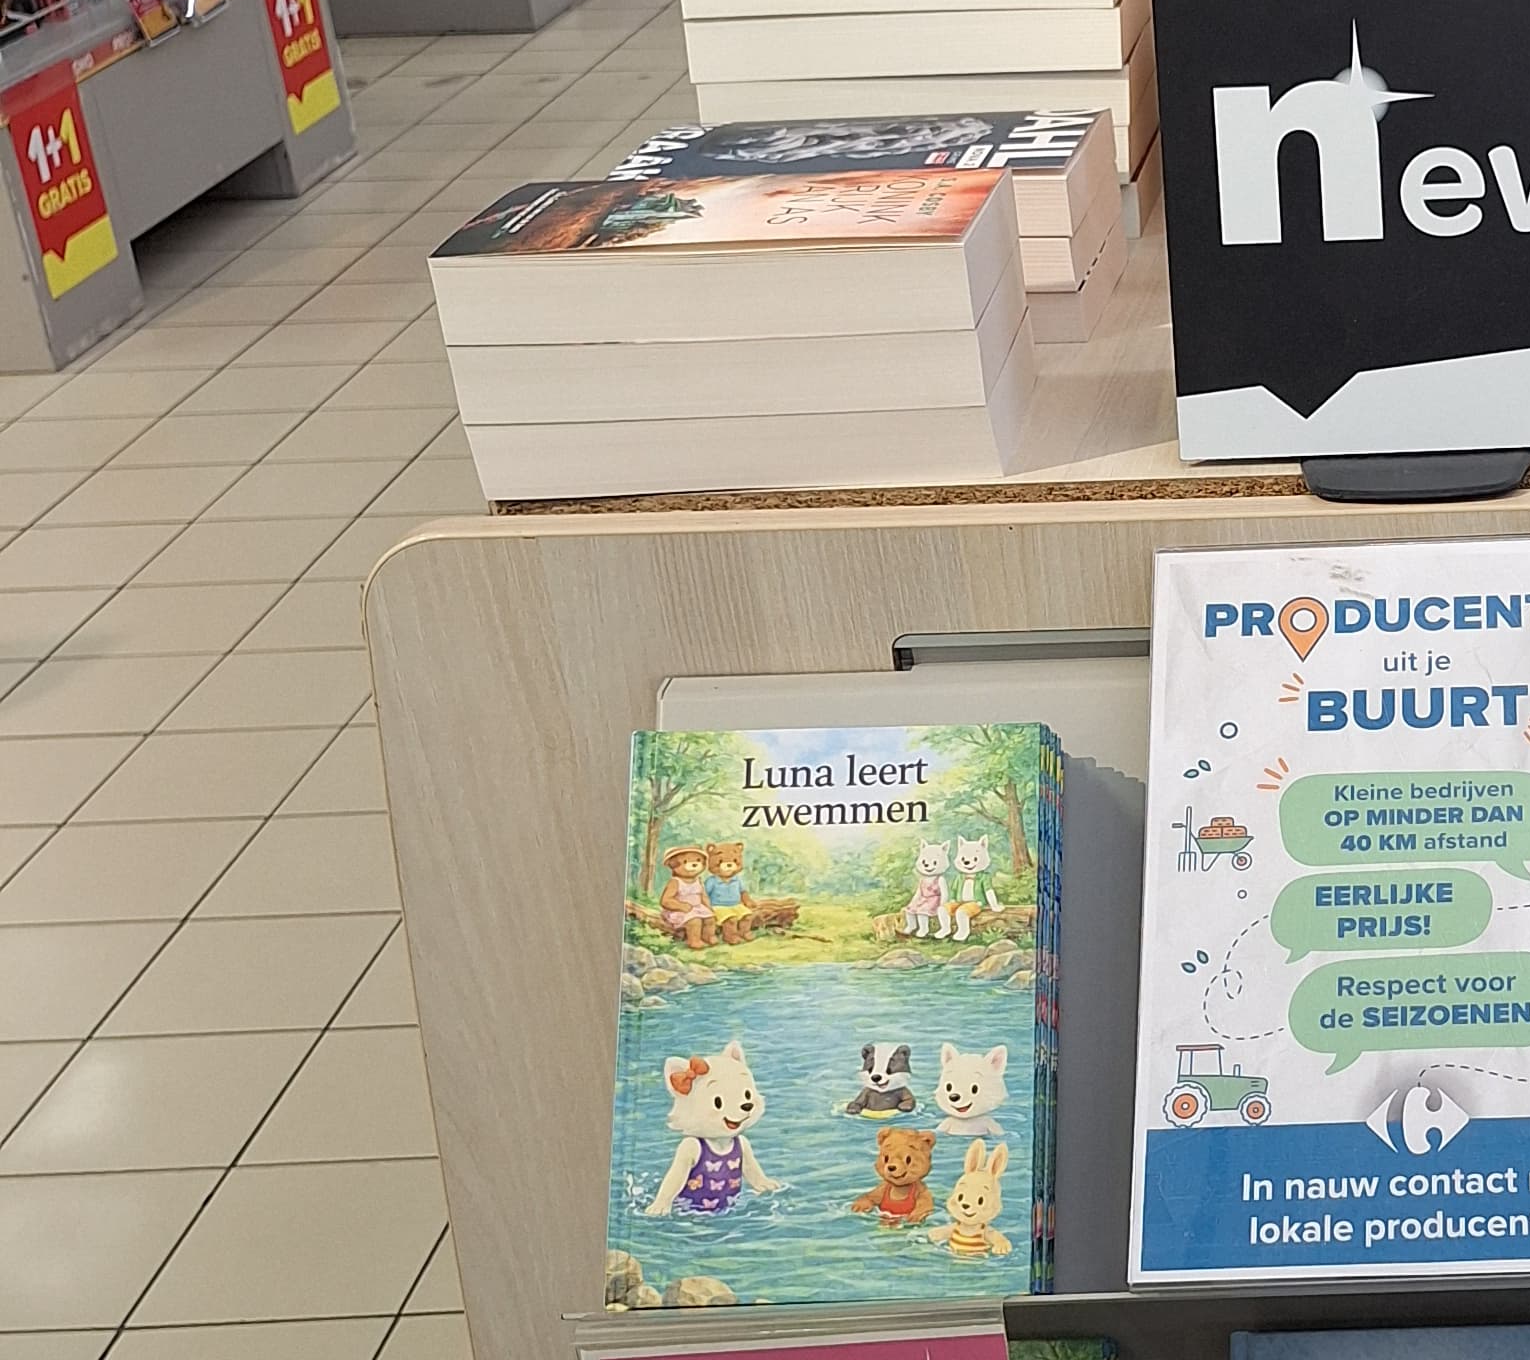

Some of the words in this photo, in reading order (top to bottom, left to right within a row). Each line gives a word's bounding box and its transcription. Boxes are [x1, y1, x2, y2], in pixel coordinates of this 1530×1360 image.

[283, 27, 322, 68] GRATIS
[27, 107, 82, 184] 1+1
[38, 168, 92, 219] GRATIS
[1382, 651, 1416, 674] uit
[1423, 650, 1451, 677] je
[1307, 685, 1530, 732] BUURT
[742, 756, 833, 791] Luna
[846, 754, 929, 786] leert
[1334, 784, 1403, 803] Kleine
[1410, 781, 1514, 806] bedrijven
[741, 799, 930, 828] zwemmen
[1324, 809, 1359, 828] OP
[1366, 806, 1464, 827] MINDER
[1472, 805, 1523, 824] DAN
[1340, 834, 1373, 852] 40
[1379, 833, 1417, 851] KM
[1423, 831, 1508, 850] afstand
[1315, 882, 1453, 907] EERLIJKE
[1337, 915, 1431, 938] PRIJS!
[1336, 975, 1447, 999] Respect
[1455, 974, 1517, 994] voor
[1319, 1008, 1353, 1029] de
[1241, 1172, 1274, 1202] In
[1284, 1174, 1379, 1200] nauw
[1389, 1167, 1518, 1197] contact
[1248, 1215, 1354, 1245] lokale
